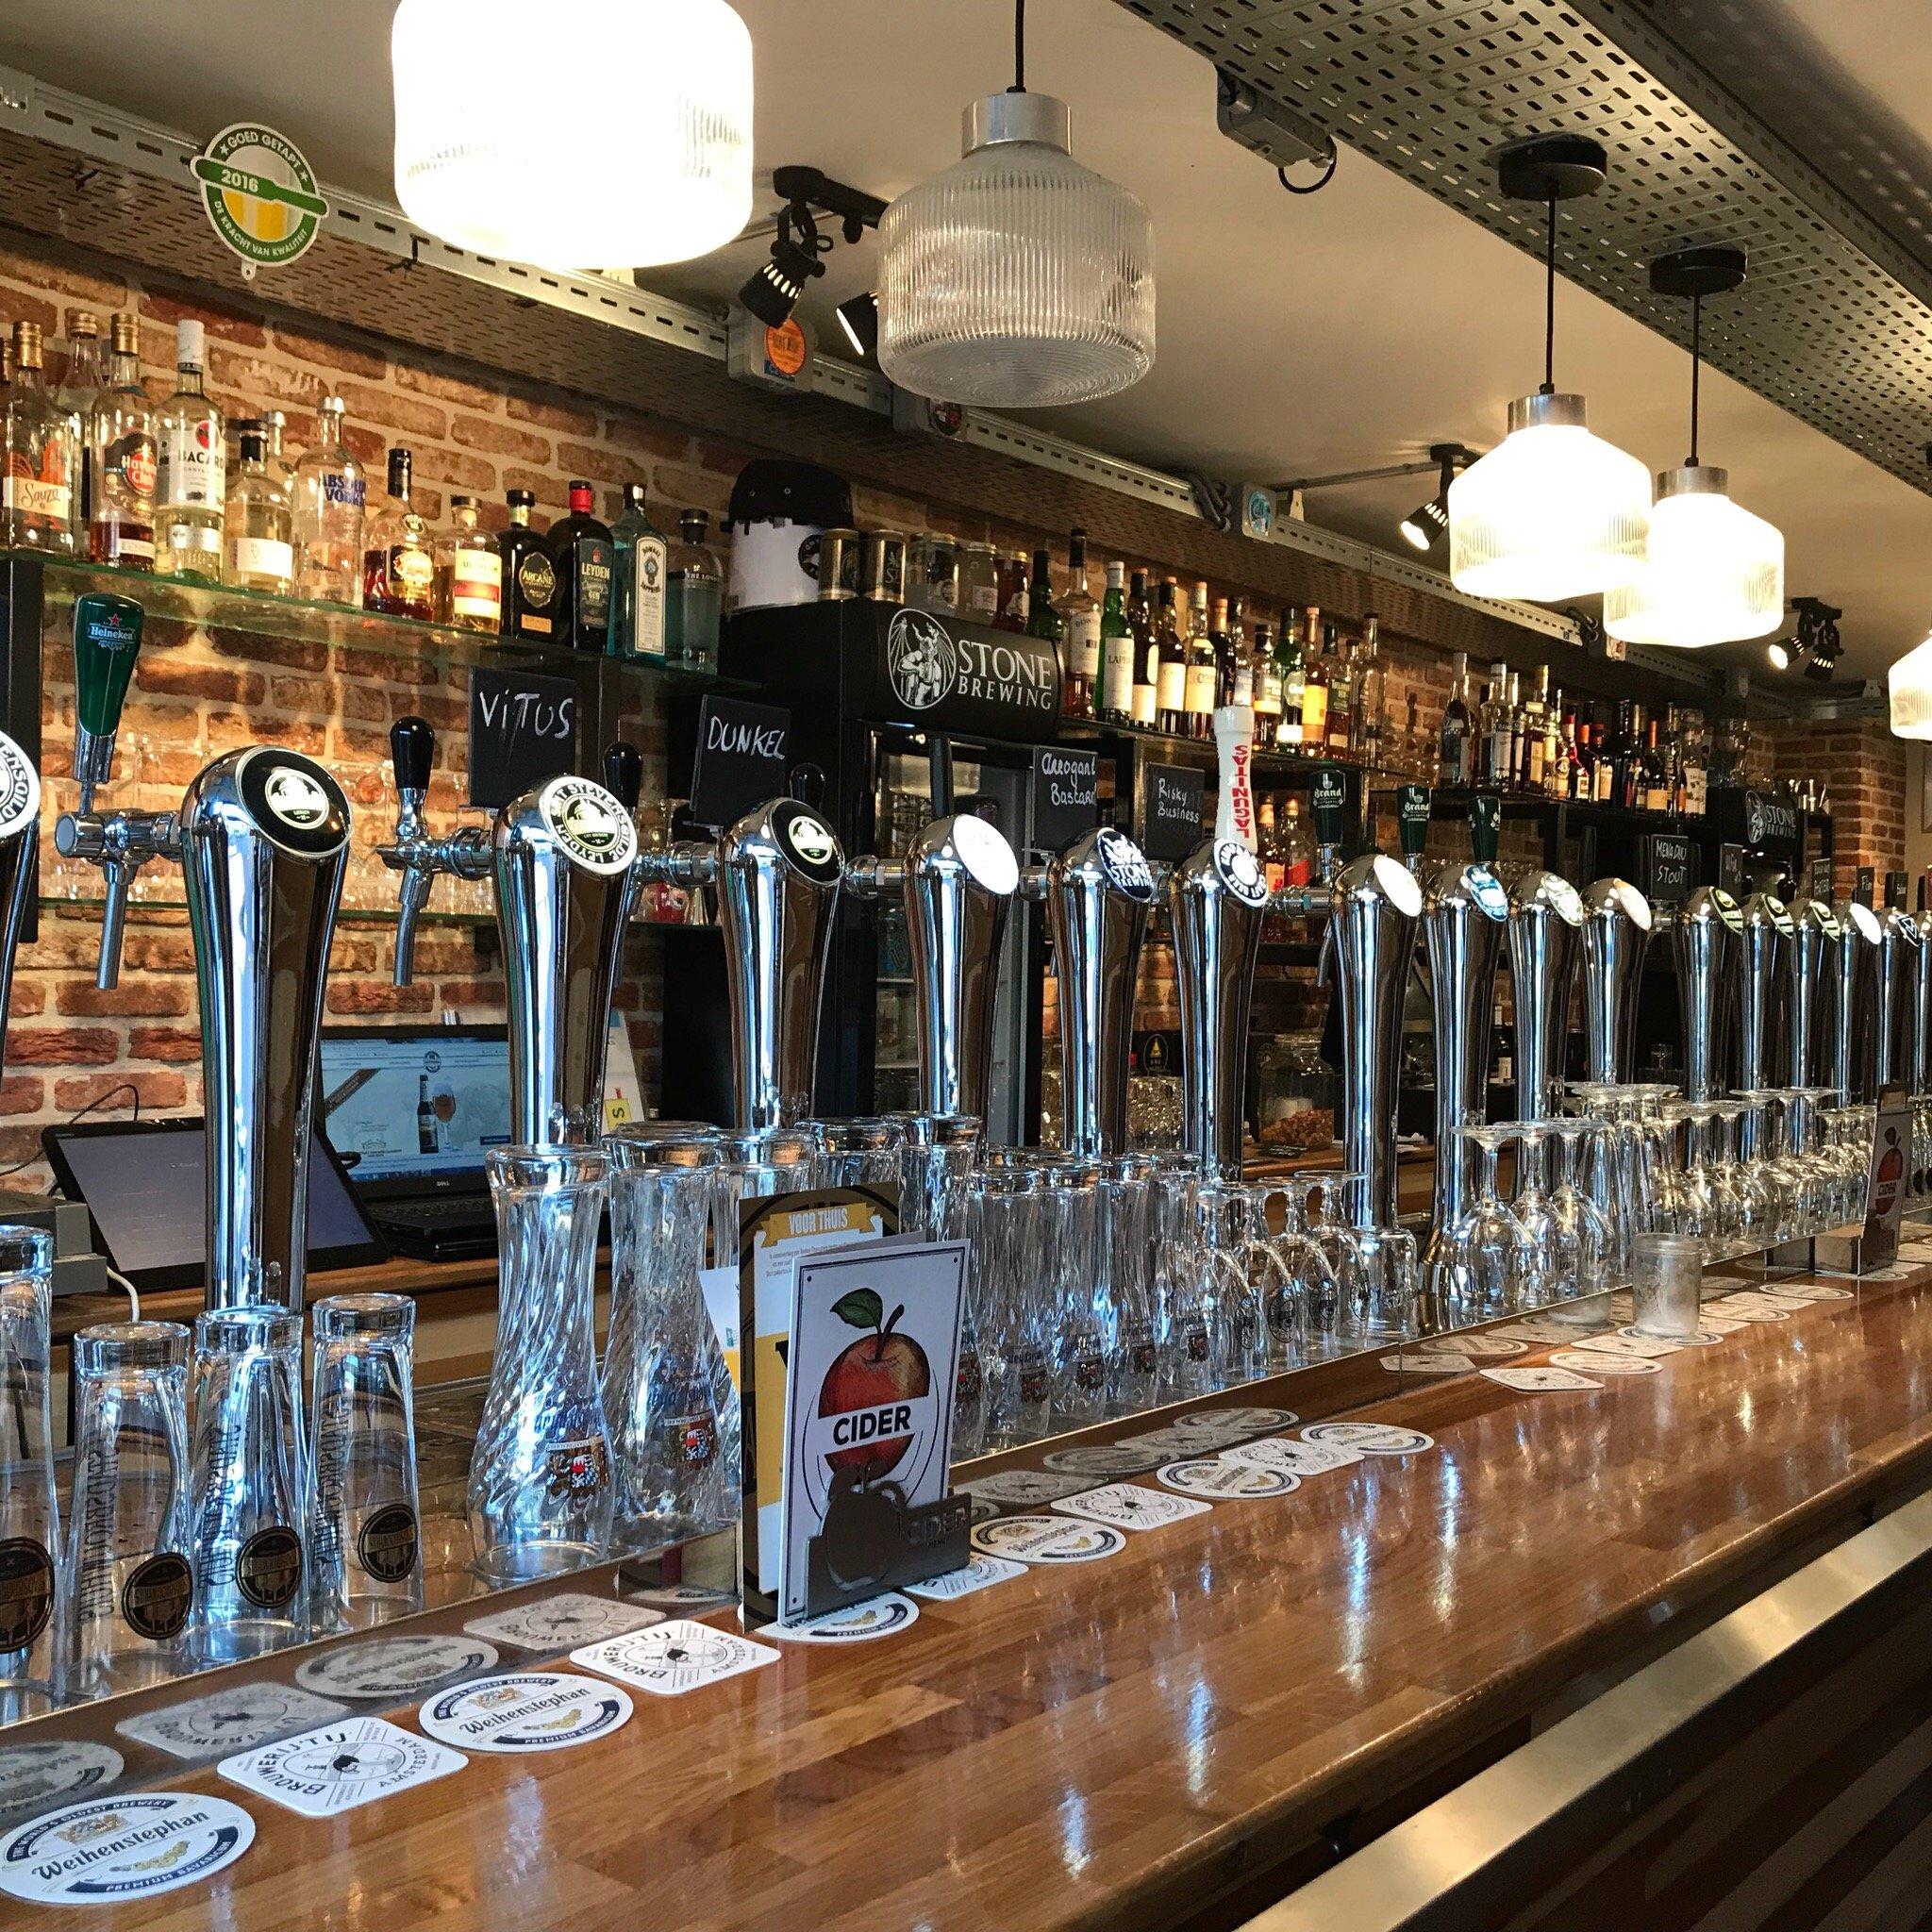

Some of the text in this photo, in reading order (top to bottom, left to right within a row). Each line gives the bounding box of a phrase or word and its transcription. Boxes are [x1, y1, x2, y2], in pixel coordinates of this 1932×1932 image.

[227, 131, 301, 168] GOED GETAPT
[221, 169, 258, 192] 2016
[214, 200, 308, 257] DE KRACHT VAN KWALITEIT
[22, 483, 60, 508] Sauza
[522, 570, 554, 585] ARCANE
[581, 562, 610, 579] LEYDEN
[91, 625, 133, 641] Heineken
[958, 640, 1052, 690] STONE
[958, 675, 1052, 710] BREWING
[707, 715, 786, 760] DUNKEL
[1158, 777, 1188, 807] Risky
[1232, 744, 1251, 839] LAGUNITAS
[1314, 788, 1341, 799] Brand
[1158, 801, 1200, 824] Business
[1405, 802, 1430, 812] Brand
[556, 824, 605, 864] LEYDEN
[789, 1208, 848, 1236] VOOR THUIS
[833, 1405, 911, 1446] CIDER
[459, 1687, 591, 1734] Weihenstephan
[525, 1732, 577, 1744] PREMIUM
[257, 1742, 327, 1795] BROUWERIJ
[378, 1737, 428, 1789] AMSTERDAM
[112, 1799, 169, 1808] BREWERY
[31, 1809, 210, 1881] Weihenstephan
[106, 1874, 174, 1891] PREMIUM
